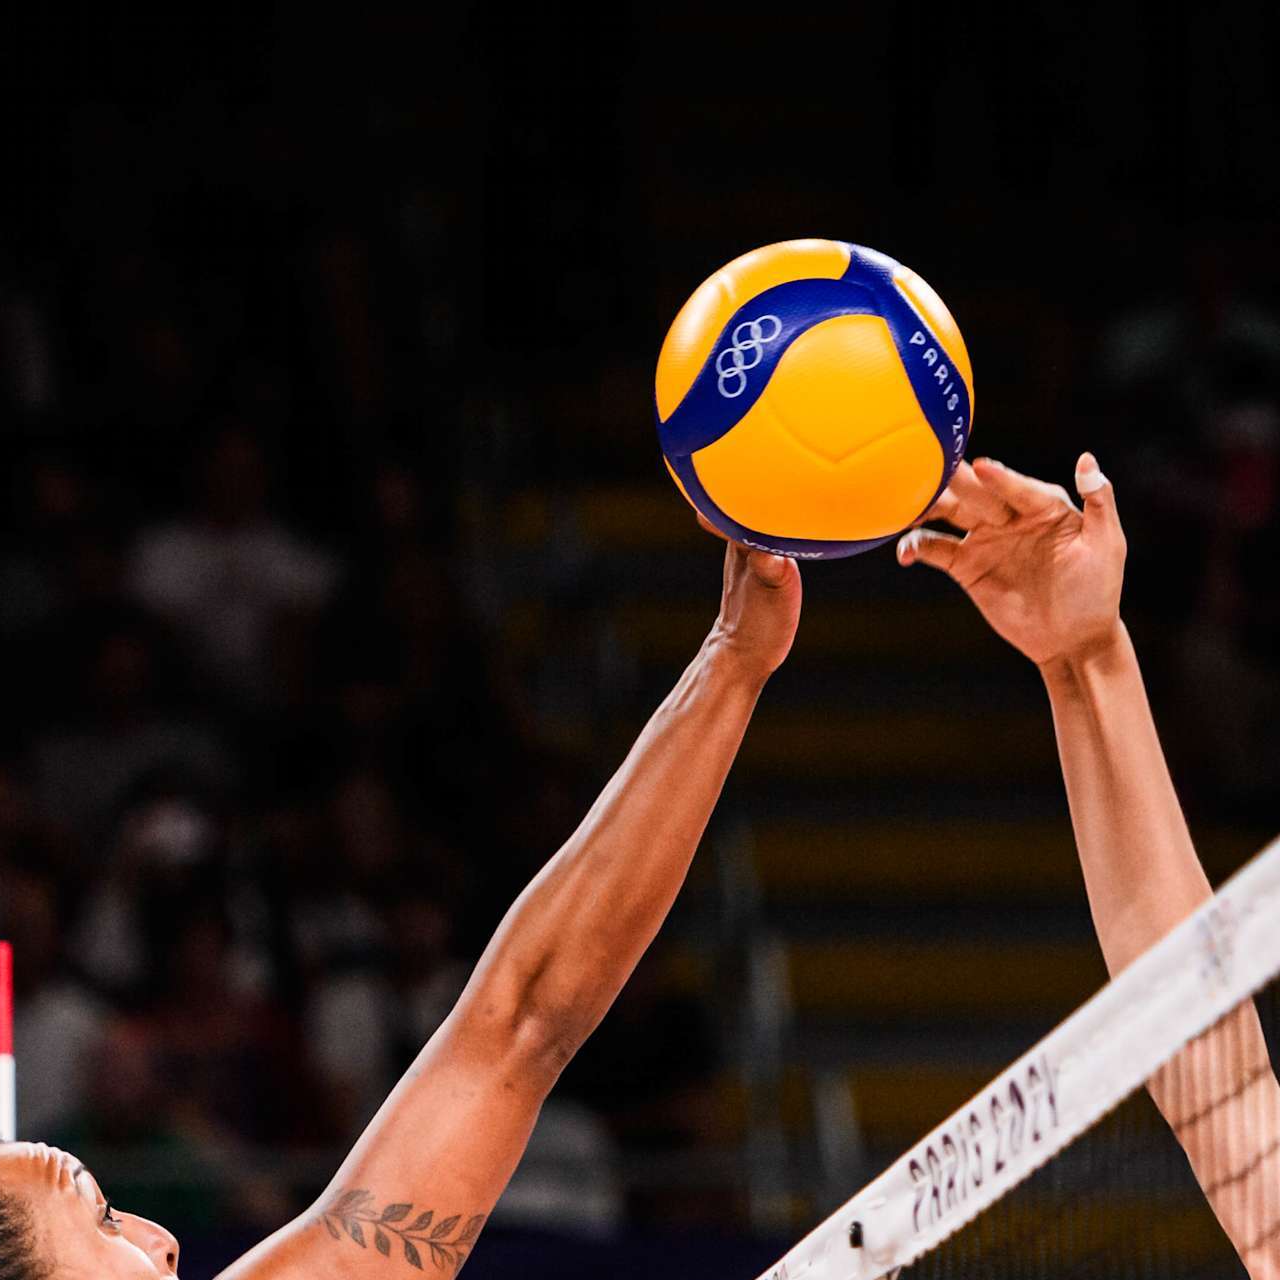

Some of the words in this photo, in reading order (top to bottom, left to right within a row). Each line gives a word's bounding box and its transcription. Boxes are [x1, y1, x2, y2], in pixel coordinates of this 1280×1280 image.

[909, 331, 959, 411] PARIS
[908, 1111, 984, 1233] PARIS
[989, 1053, 1061, 1175] 2024
